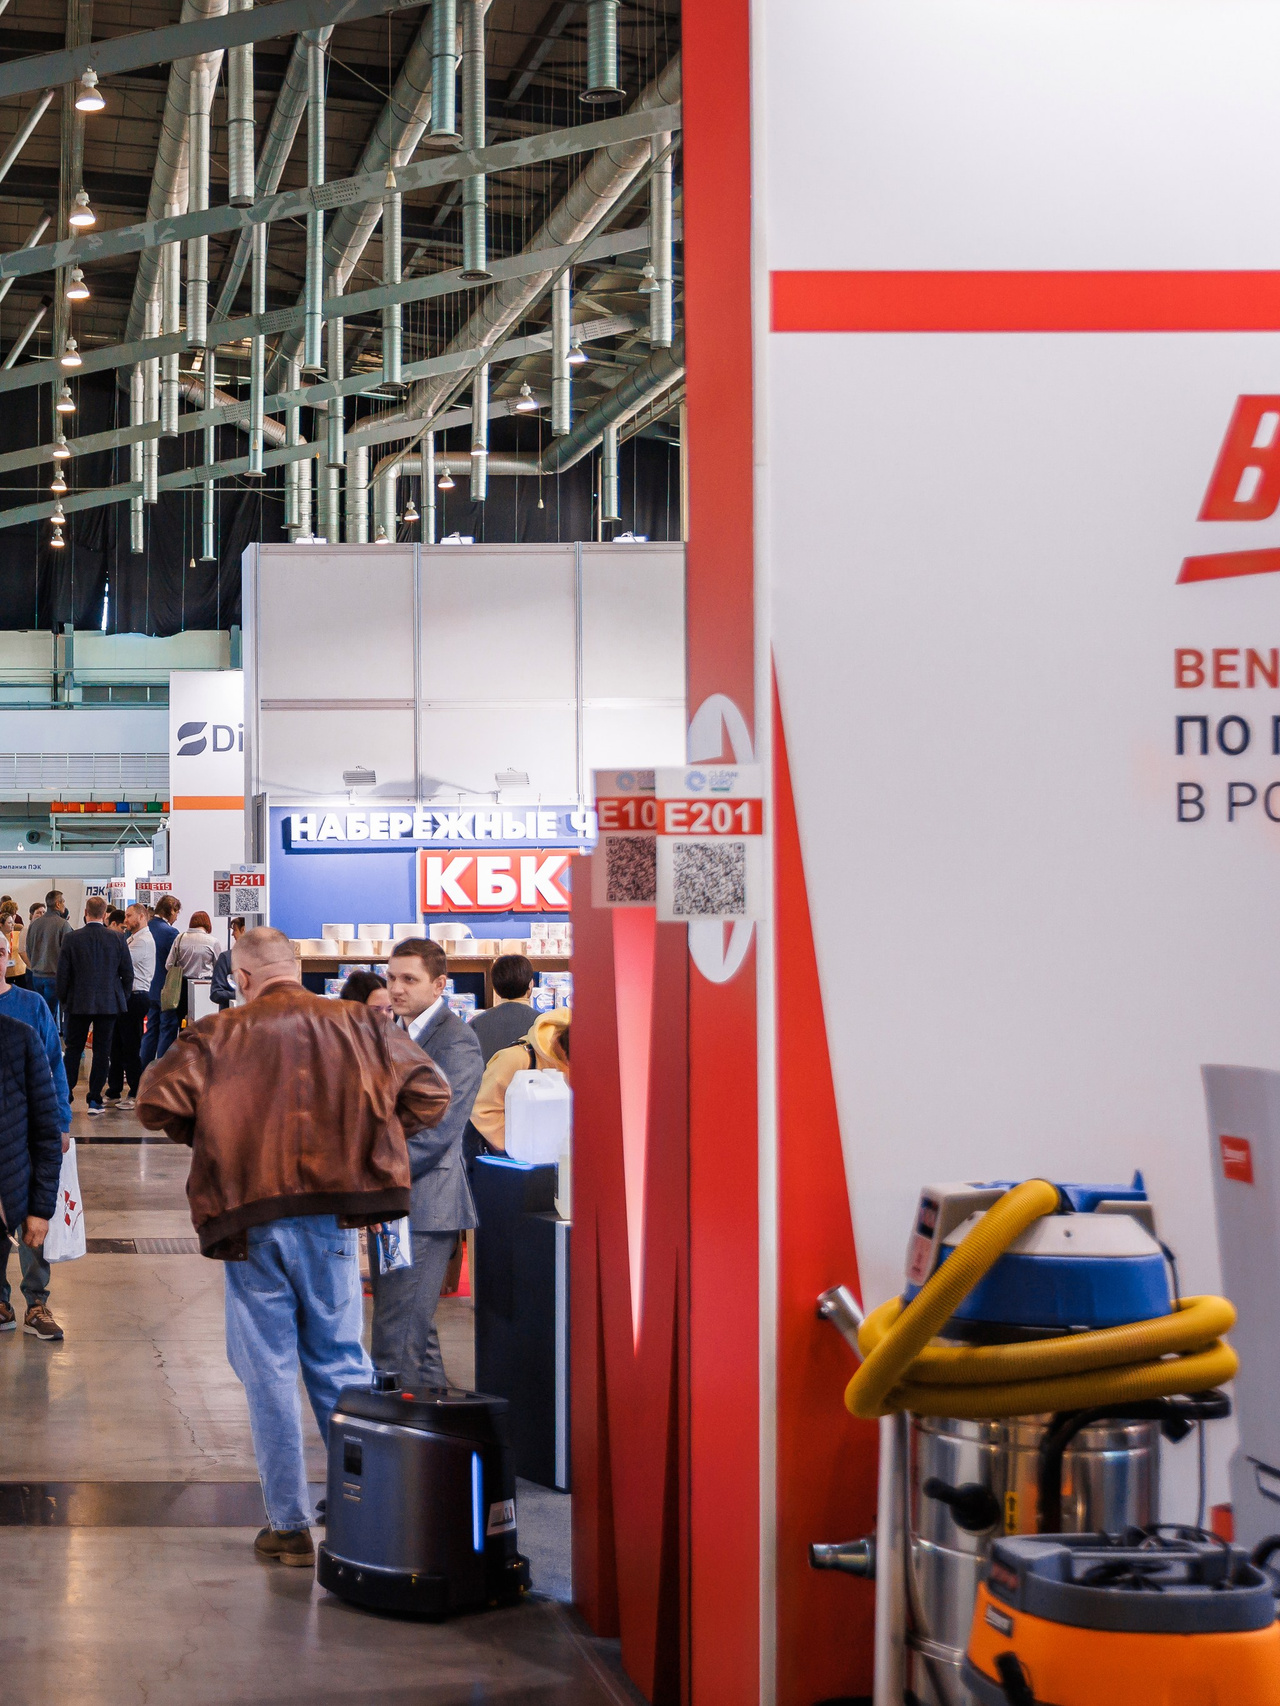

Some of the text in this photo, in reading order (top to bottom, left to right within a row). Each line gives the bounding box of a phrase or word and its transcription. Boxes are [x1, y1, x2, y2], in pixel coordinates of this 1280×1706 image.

[212, 723, 244, 752] Di
[1175, 715, 1251, 755] ПО
[664, 802, 751, 833] E201
[1176, 782, 1206, 822] В
[290, 812, 557, 841] НАБЕРЕЖНЫЕ
[232, 875, 261, 886] E211
[426, 855, 568, 906] КБК
